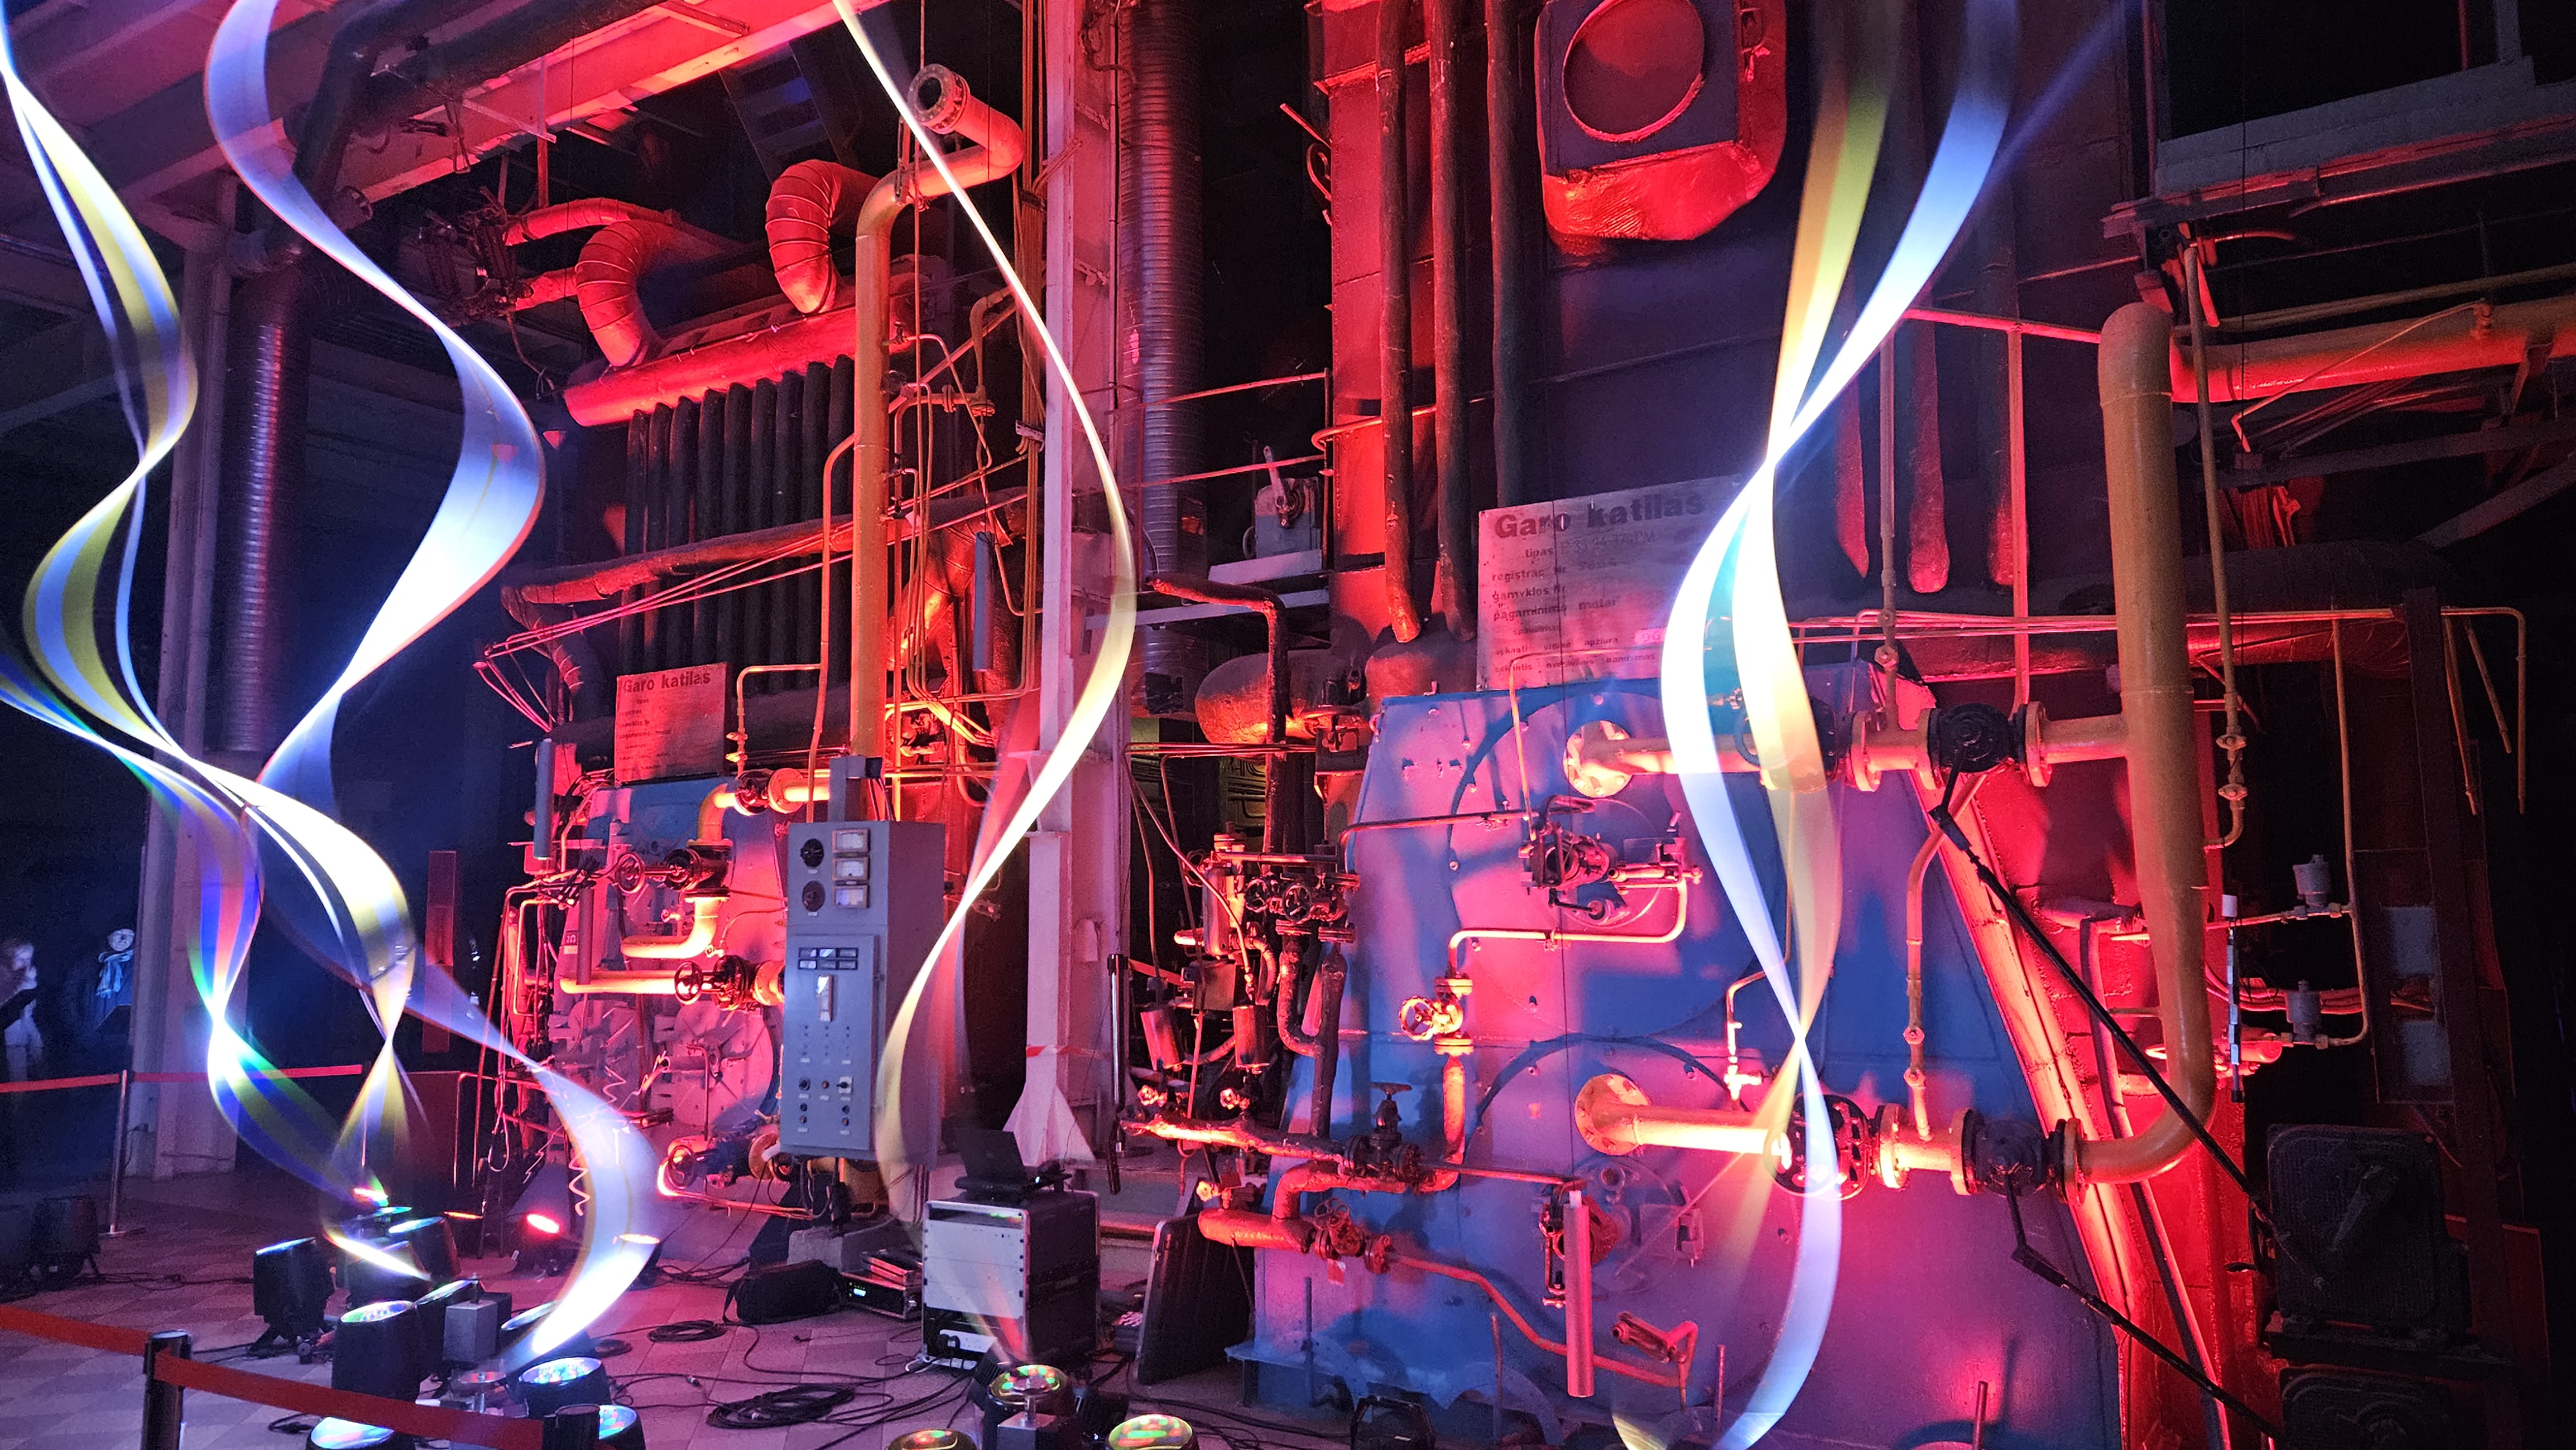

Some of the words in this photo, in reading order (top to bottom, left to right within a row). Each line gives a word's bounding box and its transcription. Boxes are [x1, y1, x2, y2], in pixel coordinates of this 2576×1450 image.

[1495, 513, 1571, 539] Garo
[1587, 493, 1705, 528] katilas
[1525, 547, 1554, 560] tipas
[623, 679, 655, 693] Garo
[661, 670, 711, 689] katilas
